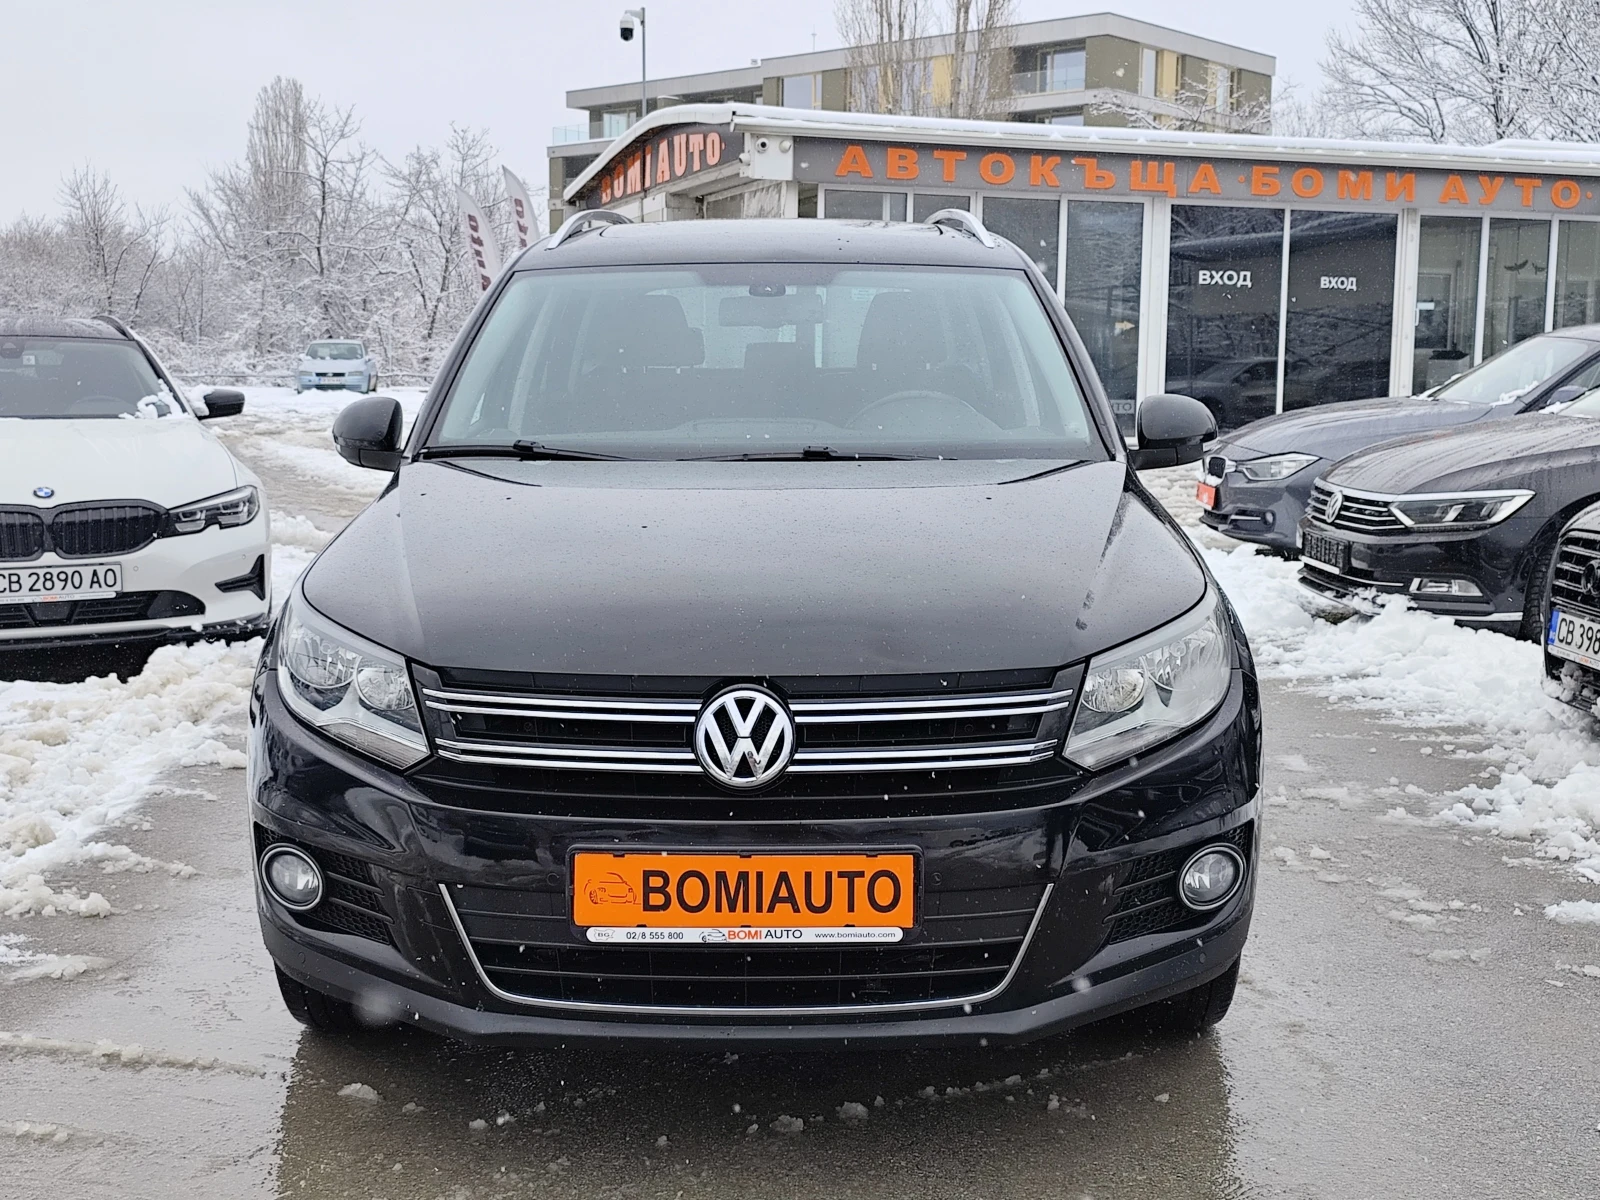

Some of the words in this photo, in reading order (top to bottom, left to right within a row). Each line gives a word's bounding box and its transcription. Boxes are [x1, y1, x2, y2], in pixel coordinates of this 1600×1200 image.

[601, 145, 651, 204] BOMI
[656, 132, 722, 184] AUTO
[835, 145, 1222, 198] АВТОКЪЩА
[1250, 165, 1417, 203] БОМИ
[1438, 174, 1582, 209] АУТО
[1198, 269, 1252, 288] ВХОД
[1320, 276, 1357, 292] ВХОД
[28, 570, 83, 592] 2890
[90, 568, 117, 589] AO
[1557, 618, 1575, 646] CB
[1575, 623, 1600, 655] 398
[641, 869, 902, 914] BOMIAUTO
[626, 931, 647, 940] 02/8
[649, 931, 665, 940] 555
[667, 931, 684, 940] 800
[728, 929, 762, 940] BOMI
[764, 929, 803, 940] AUTO
[814, 931, 896, 939] www.bomiauto.com
